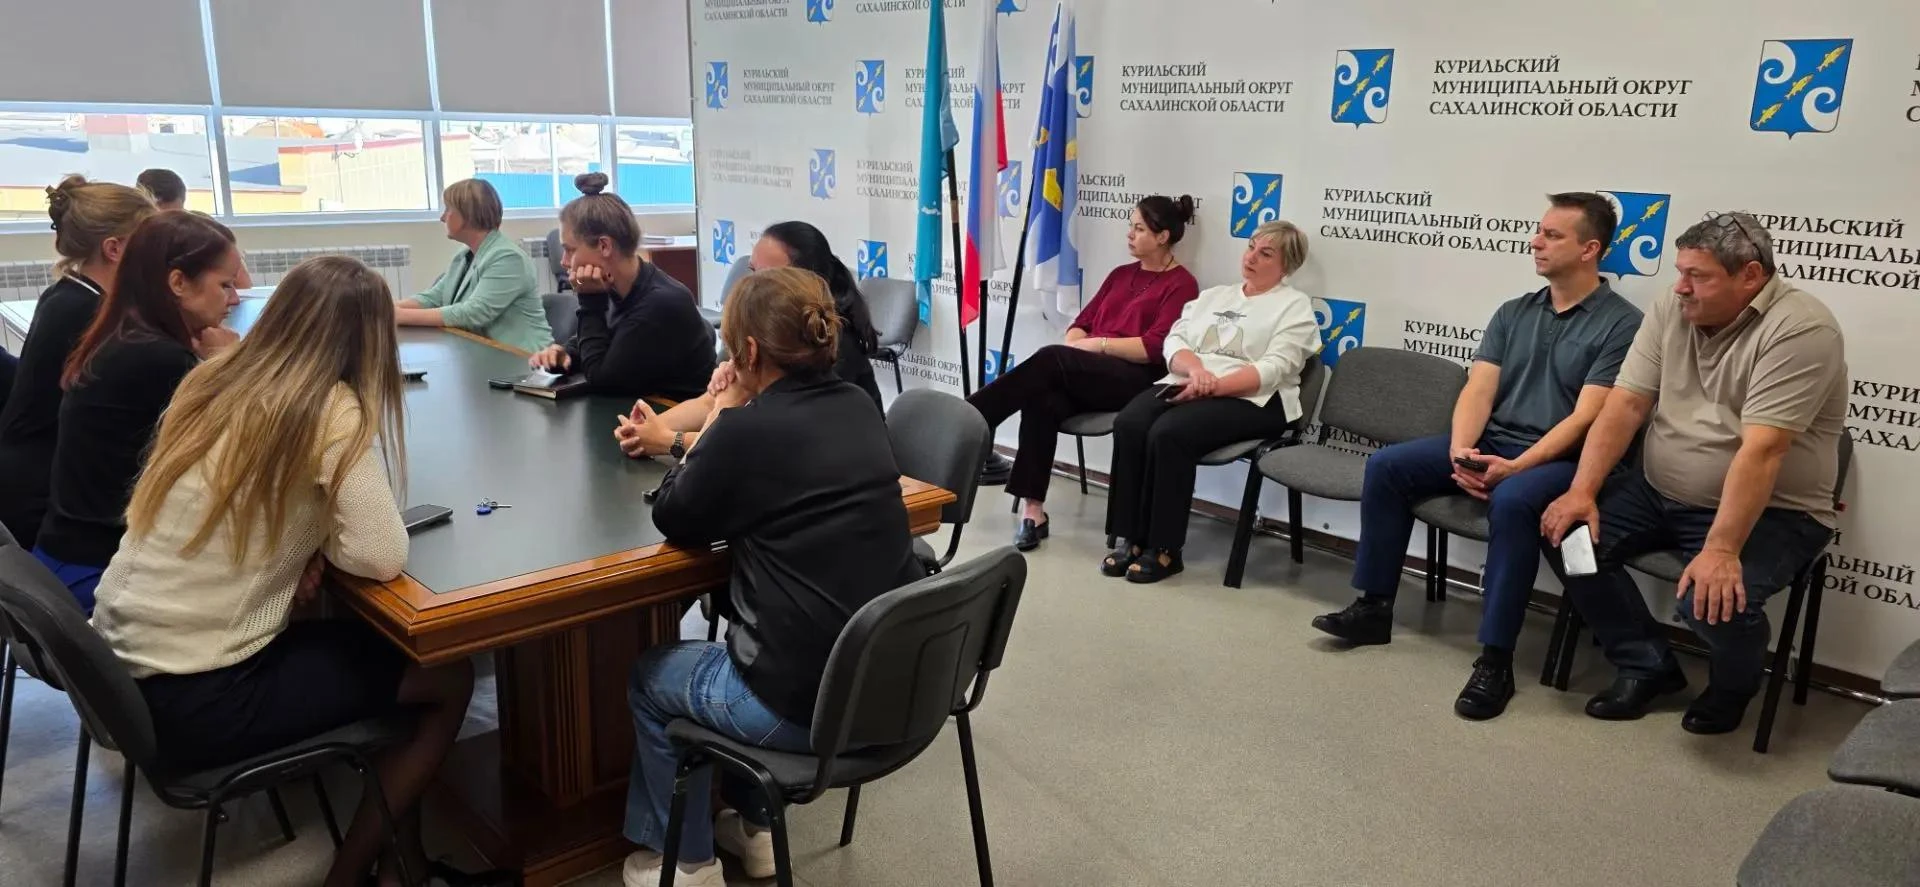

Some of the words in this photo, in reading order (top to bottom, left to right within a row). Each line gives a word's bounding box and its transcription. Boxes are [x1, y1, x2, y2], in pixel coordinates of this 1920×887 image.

[1122, 62, 1207, 77] КУРИЛЬСКИЙ
[1433, 55, 1561, 74] КУРИЛЬСКИЙ
[1001, 83, 1026, 94] КРУГ
[1121, 80, 1246, 95] МУНИЦИПАЛЬНЫЙ
[1248, 82, 1294, 94] ОКРУГ
[1431, 77, 1619, 97] МУНИЦИПАЛЬНЫЙ
[1622, 79, 1693, 95] ОКРУГ
[1120, 98, 1217, 112] САХАЛИНСКОЙ
[1219, 101, 1285, 113] ОБЛАСТИ
[1429, 99, 1574, 117] САХАЛИНСКОЙ
[1577, 102, 1679, 118] ОБЛАСТИ
[1078, 174, 1126, 188] ЛЬСКИЙ
[1323, 187, 1433, 208] КУРИЛЬСКИЙ
[1322, 206, 1483, 231] МУНИЦИПАЛЬНЫЙ
[1752, 213, 1905, 239] УРИЛЬСКИЙ
[1320, 224, 1445, 248] САХАЛИНСКОЙ
[1447, 235, 1532, 256] ОБЛАСТИ
